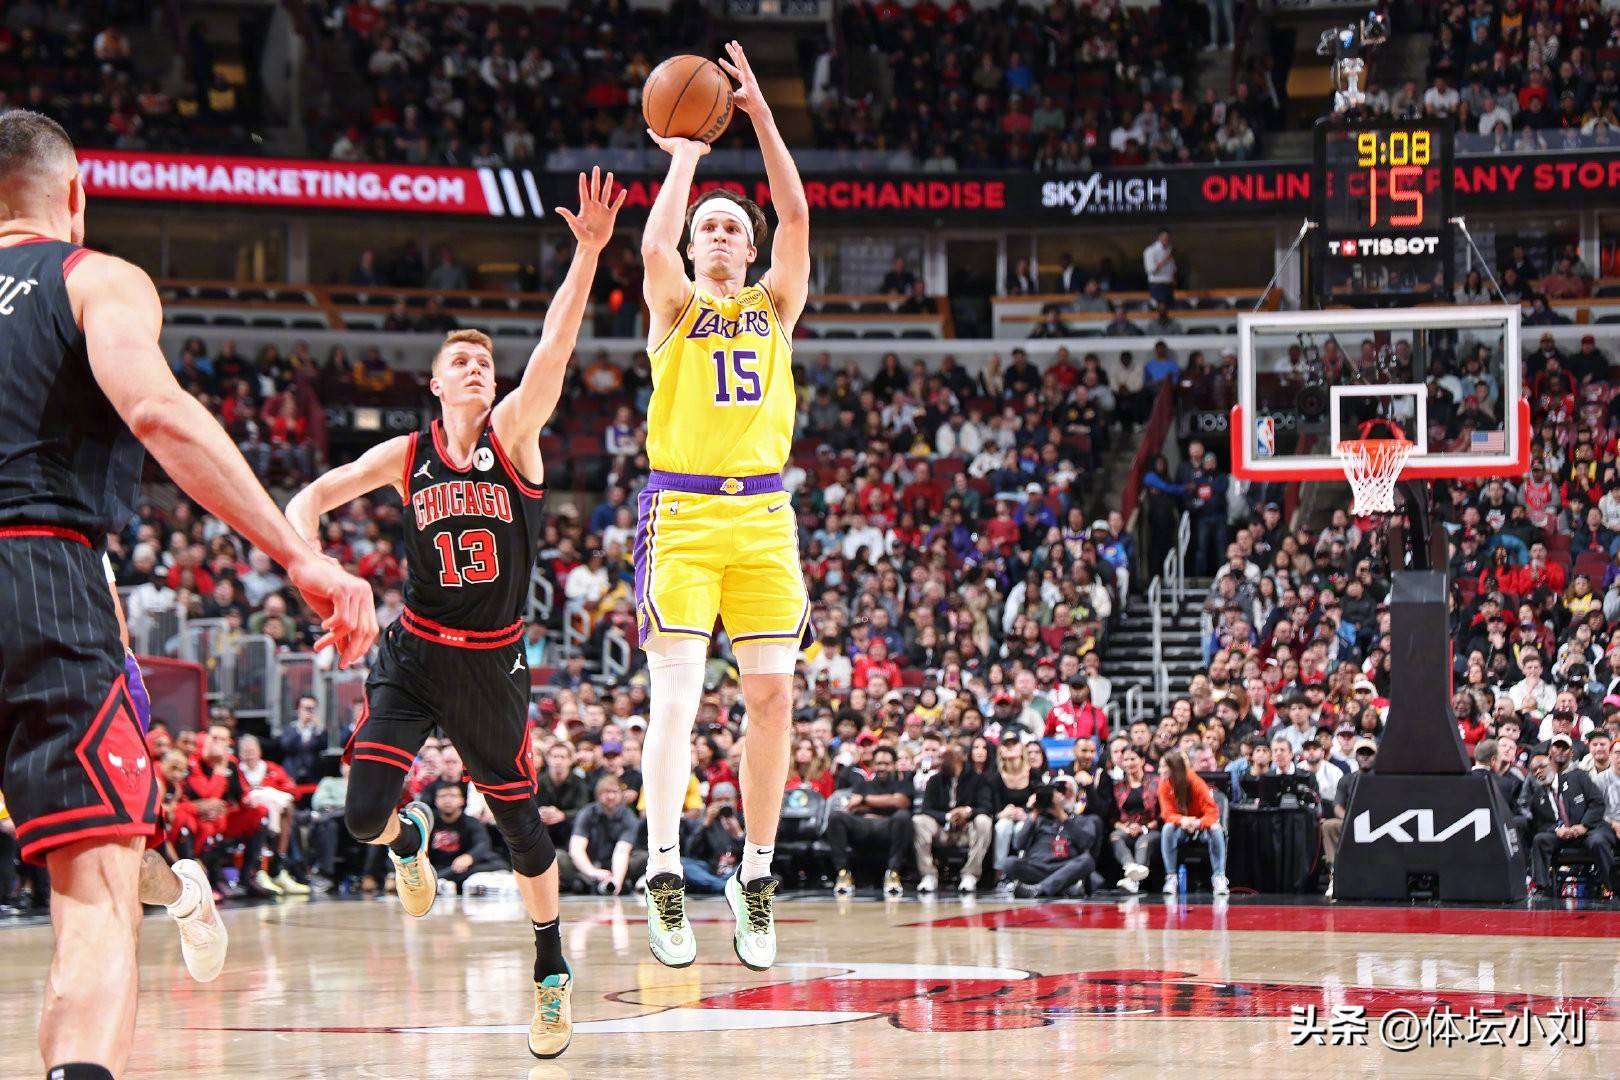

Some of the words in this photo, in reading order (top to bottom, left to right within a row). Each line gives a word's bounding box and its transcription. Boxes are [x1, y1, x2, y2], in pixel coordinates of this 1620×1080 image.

[1358, 131, 1430, 166] 9:08
[1369, 165, 1423, 227] 15
[1358, 237, 1439, 256] TISSOT
[686, 307, 770, 338] LAKERS
[712, 349, 763, 404] 15
[412, 480, 514, 531] CHICAGO
[433, 528, 500, 587] 13
